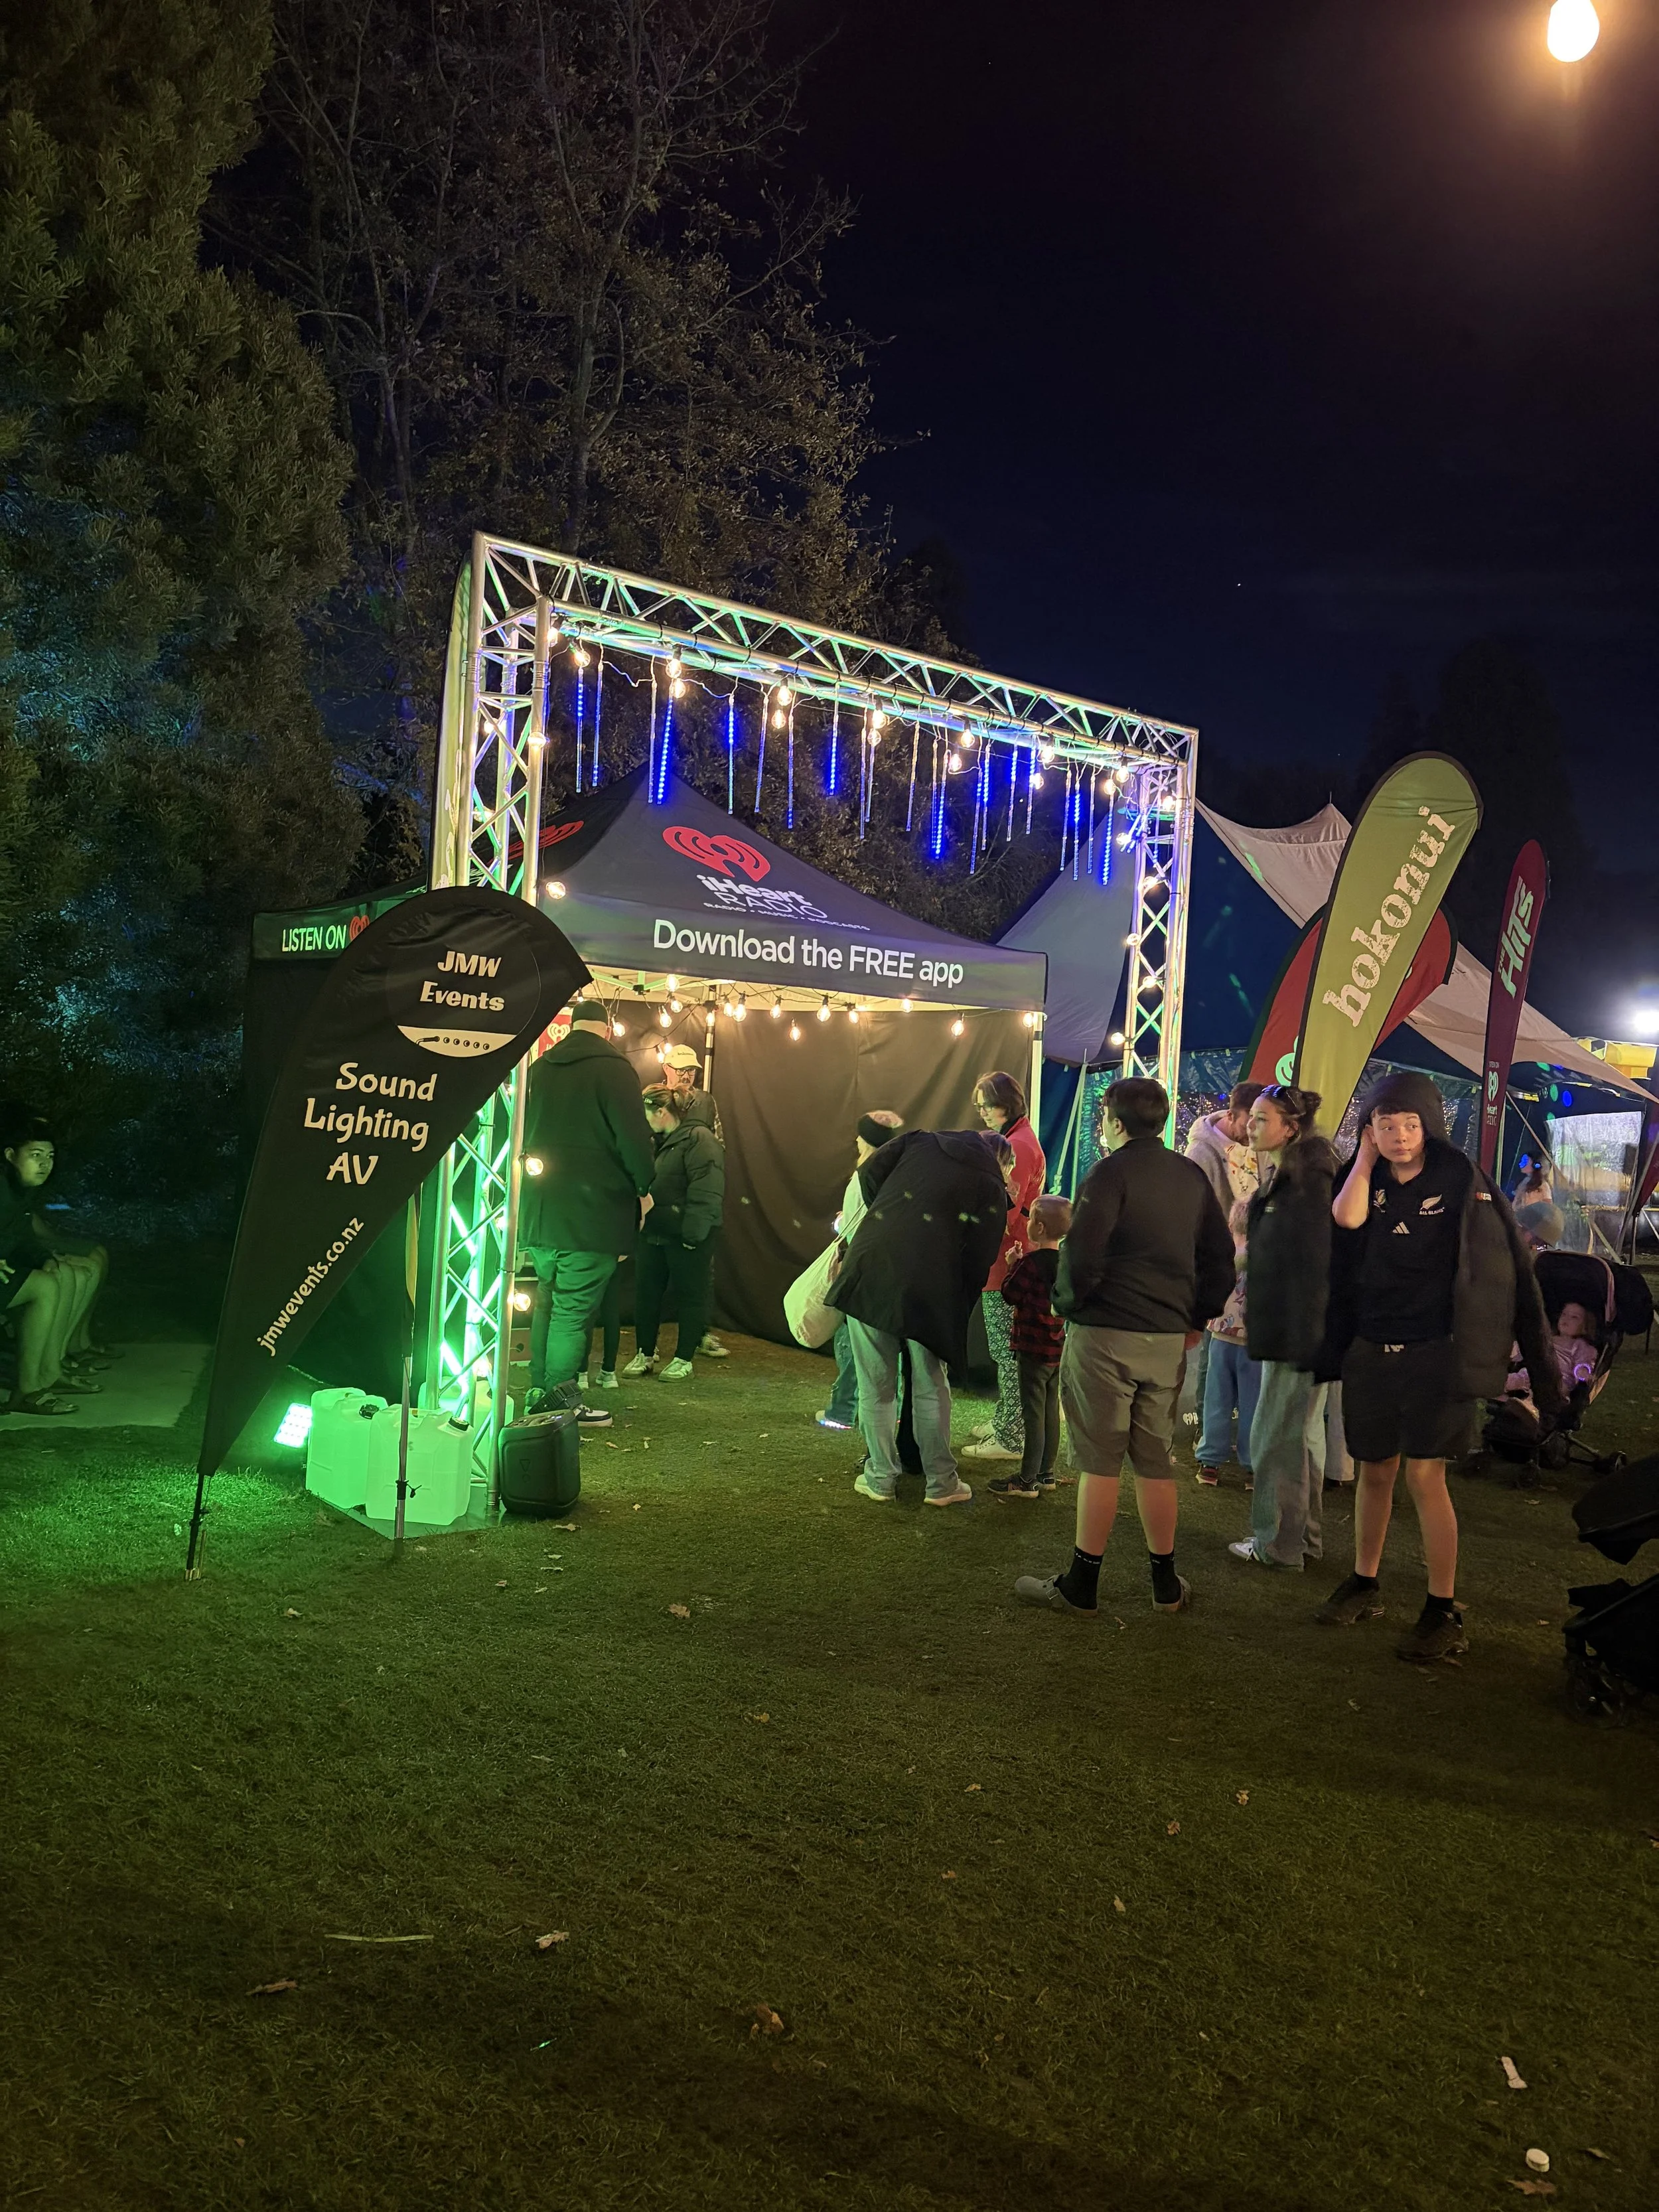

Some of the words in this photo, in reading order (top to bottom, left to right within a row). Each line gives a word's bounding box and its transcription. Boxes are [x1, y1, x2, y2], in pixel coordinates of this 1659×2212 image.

[697, 875, 812, 906] iHeart
[714, 891, 828, 919] RADIO
[703, 902, 747, 913] RADIO
[1322, 806, 1455, 1027] hokonui
[282, 926, 323, 952] LISTEN
[325, 924, 346, 950] ON
[654, 919, 795, 964] Download
[802, 938, 842, 970] the
[849, 945, 916, 979] FREE
[919, 960, 964, 988] app
[437, 950, 502, 978] JMW
[419, 980, 505, 1011] Events
[336, 1063, 437, 1101] Sound
[304, 1098, 429, 1152] Lighting
[326, 1151, 379, 1185] AV
[256, 1217, 364, 1357] jmwevents.co.nz
